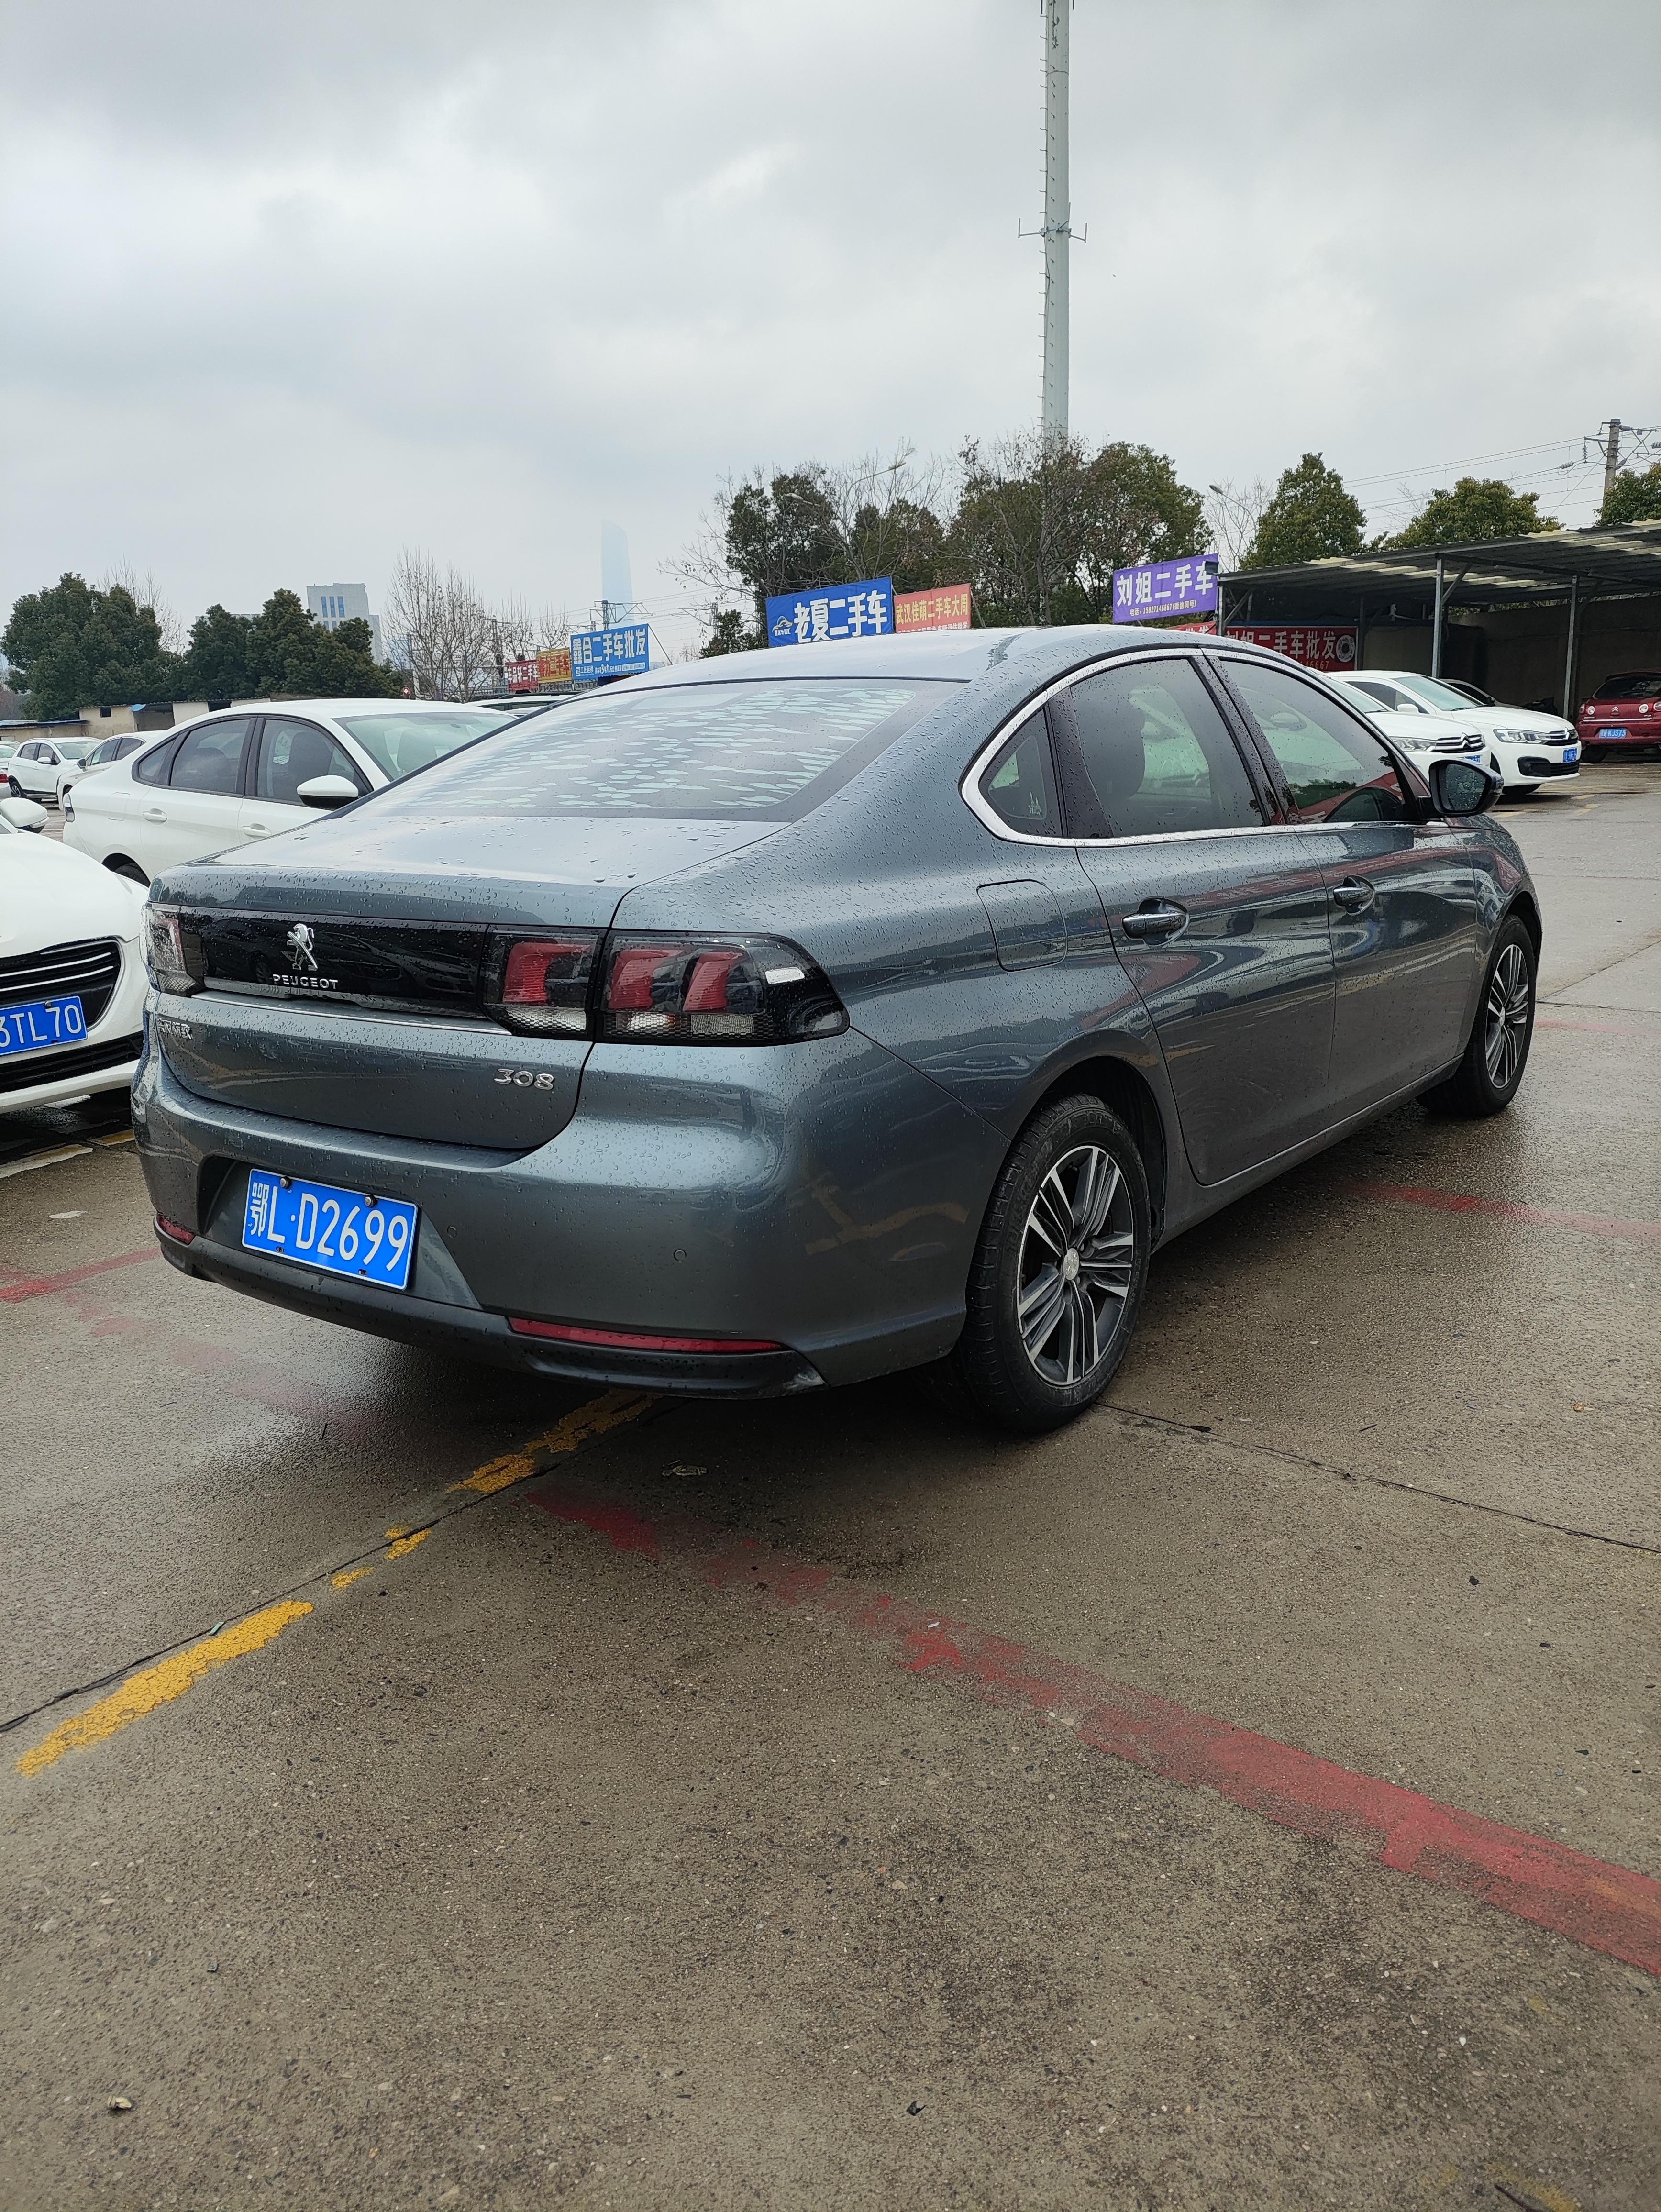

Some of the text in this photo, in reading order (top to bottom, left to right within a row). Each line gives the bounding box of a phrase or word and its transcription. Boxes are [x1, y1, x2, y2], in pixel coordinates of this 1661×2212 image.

[1117, 561, 1213, 607] 刘姐二手车
[794, 590, 887, 643] 老夏二手车
[896, 594, 968, 624] 武汉佳萌二手车大周
[573, 628, 646, 664] 鑫合二手车批发
[1225, 630, 1336, 660] 手车批发
[273, 974, 338, 989] PEUGEOT
[0, 1005, 82, 1047] 3TL70
[494, 1068, 554, 1090] 308
